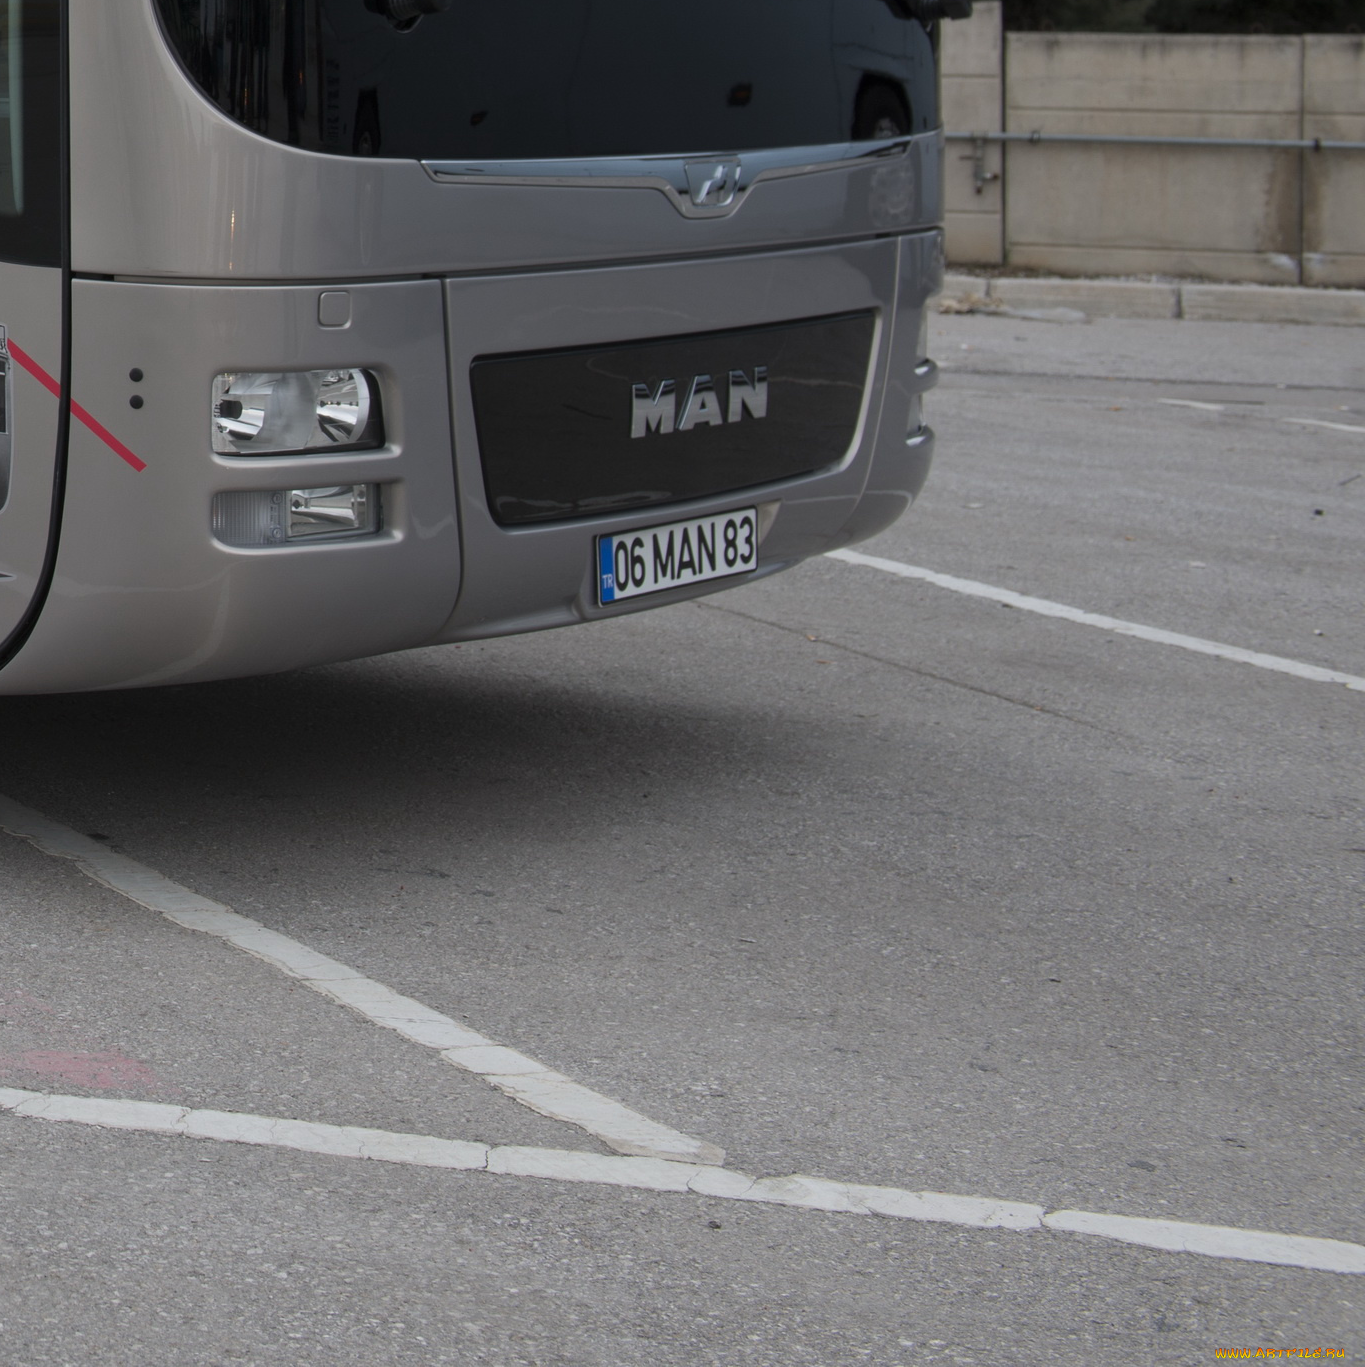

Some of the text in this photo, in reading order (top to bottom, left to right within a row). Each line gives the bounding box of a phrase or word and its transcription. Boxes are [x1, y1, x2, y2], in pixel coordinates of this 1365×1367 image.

[631, 366, 768, 439] MAN
[602, 516, 754, 592] TR 06 MAN 83
